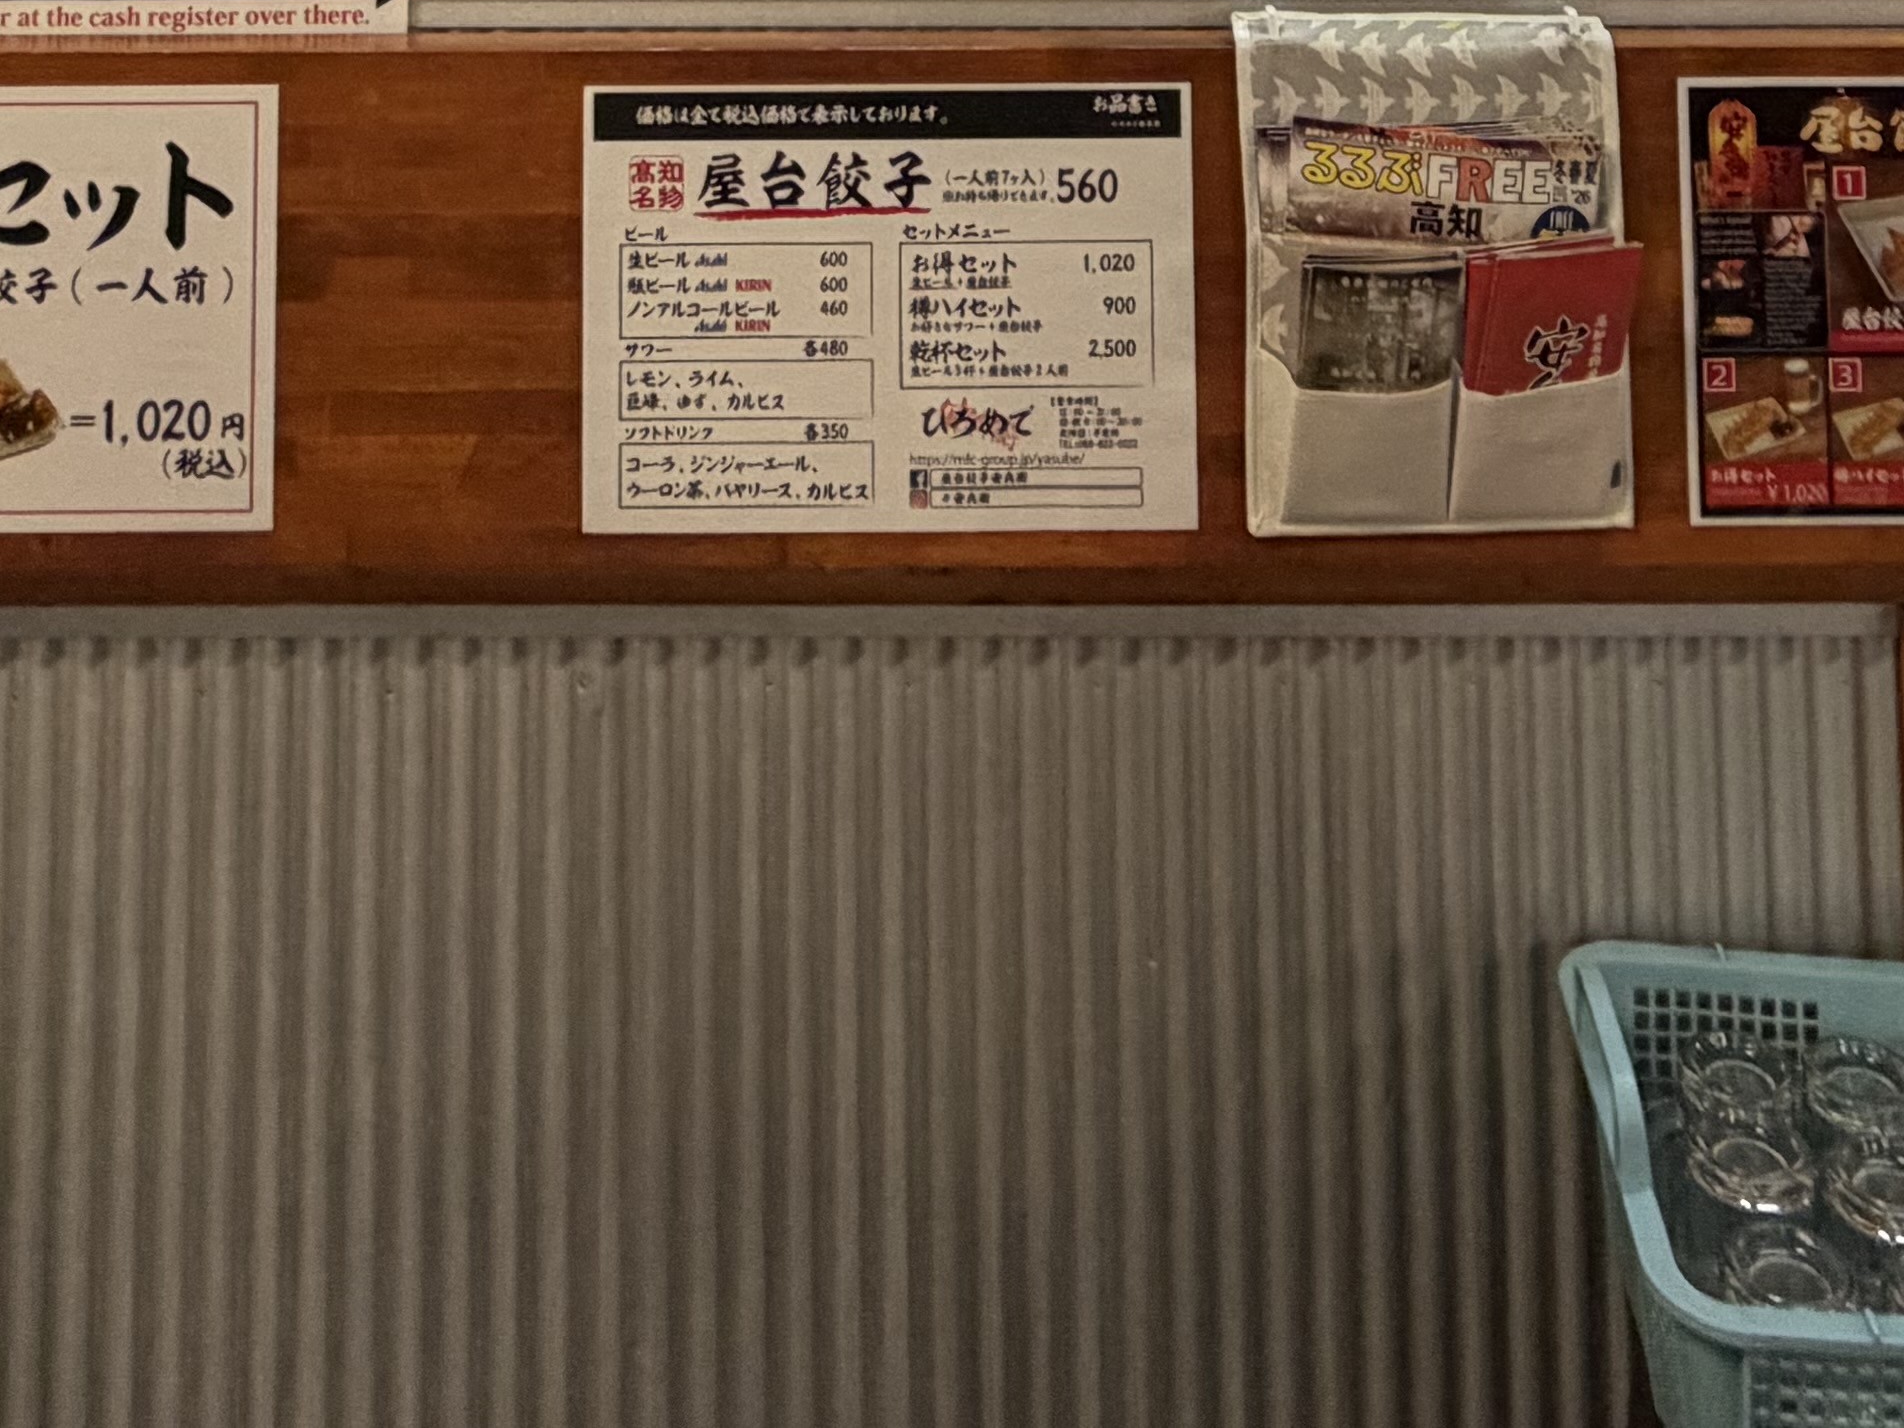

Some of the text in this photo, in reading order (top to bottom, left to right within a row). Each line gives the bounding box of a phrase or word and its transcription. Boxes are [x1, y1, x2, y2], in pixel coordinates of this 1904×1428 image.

[17, 9, 41, 28] at
[45, 6, 84, 28] the
[88, 6, 142, 28] cash
[147, 8, 240, 33] register
[244, 11, 297, 28] over
[302, 6, 372, 28] there.
[629, 159, 684, 185] 高知
[697, 149, 932, 211] 屋台餃子
[1301, 140, 1552, 205] るるぶ FREE
[1056, 167, 1120, 205] 560
[629, 185, 684, 210] 名物
[1409, 200, 1485, 240] 高知
[624, 225, 669, 243] ビール
[902, 222, 1011, 240] セットメニュー
[627, 250, 691, 269] 生ビール
[819, 250, 848, 268] 600
[911, 250, 1136, 275] お得セット 1,020
[735, 278, 772, 292] KIRIN
[819, 275, 848, 293] 600
[626, 299, 848, 319] ノンアルコールビール 460
[1102, 295, 1137, 316] 900
[734, 319, 772, 333] KIRIN
[624, 344, 673, 359] サワー
[624, 425, 714, 441] ソフトドリンク
